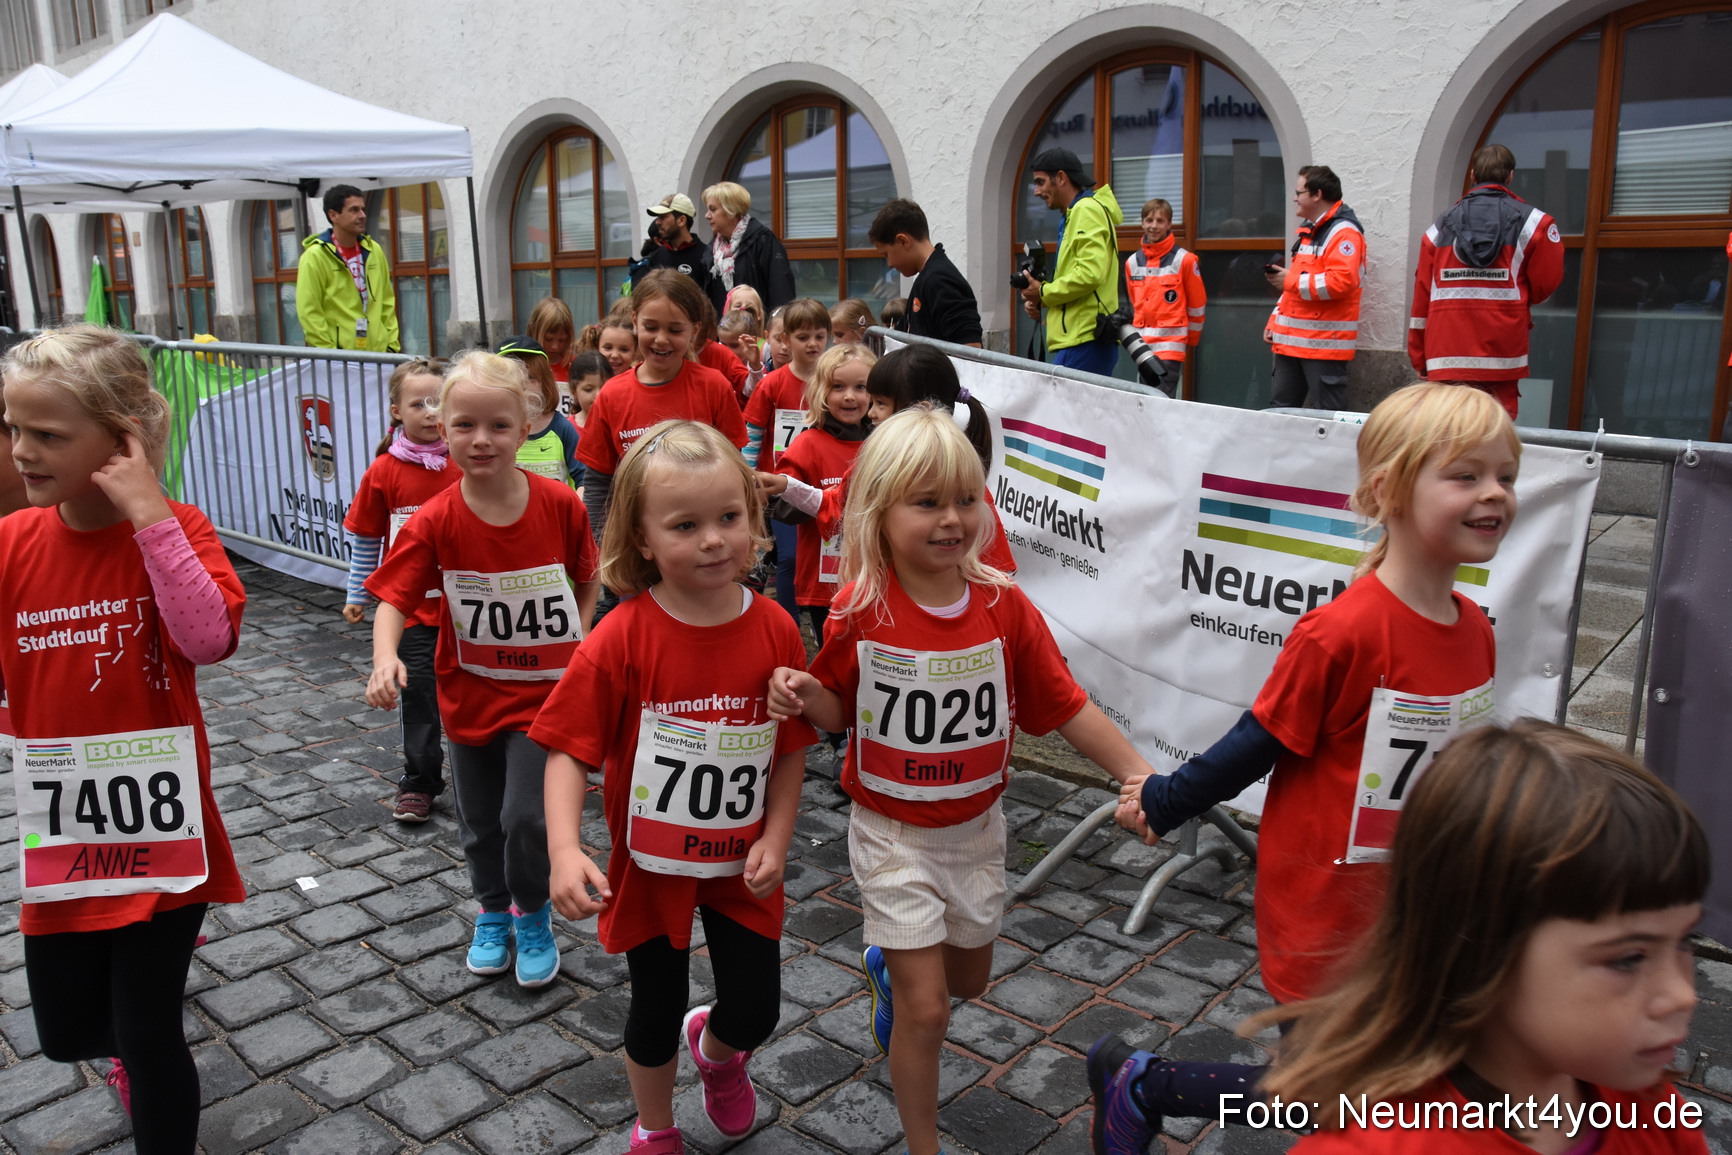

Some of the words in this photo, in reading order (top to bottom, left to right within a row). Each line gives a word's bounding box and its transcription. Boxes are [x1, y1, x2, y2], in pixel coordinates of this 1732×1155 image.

[1444, 270, 1506, 278] Sanitätsdienst
[562, 395, 570, 414] 5
[994, 474, 1106, 553] NeuerMarkt
[1005, 530, 1026, 548] aufen
[1030, 537, 1056, 559] leben
[1060, 552, 1098, 580] genießen
[456, 584, 494, 593] NeuerMarkt
[500, 569, 562, 590] BOCK
[16, 598, 129, 629] Neumarkter
[461, 595, 569, 640] 7045
[17, 622, 109, 653] Stadtlauf
[1190, 611, 1284, 647] einkaufen
[497, 651, 538, 667] Frida
[870, 660, 918, 676] NeuerMarkt
[928, 647, 995, 676] BOCK
[874, 681, 996, 744] 7029
[1388, 712, 1450, 726] NeuerMarkt
[25, 757, 76, 767] NeuerMarkt
[85, 734, 179, 762] BOCK
[654, 732, 707, 751] NeuerMarkt
[149, 754, 180, 763] concepts
[904, 759, 964, 783] Emily
[32, 771, 185, 836] 7408
[683, 834, 745, 858] Paula
[65, 846, 150, 881] ANNE
